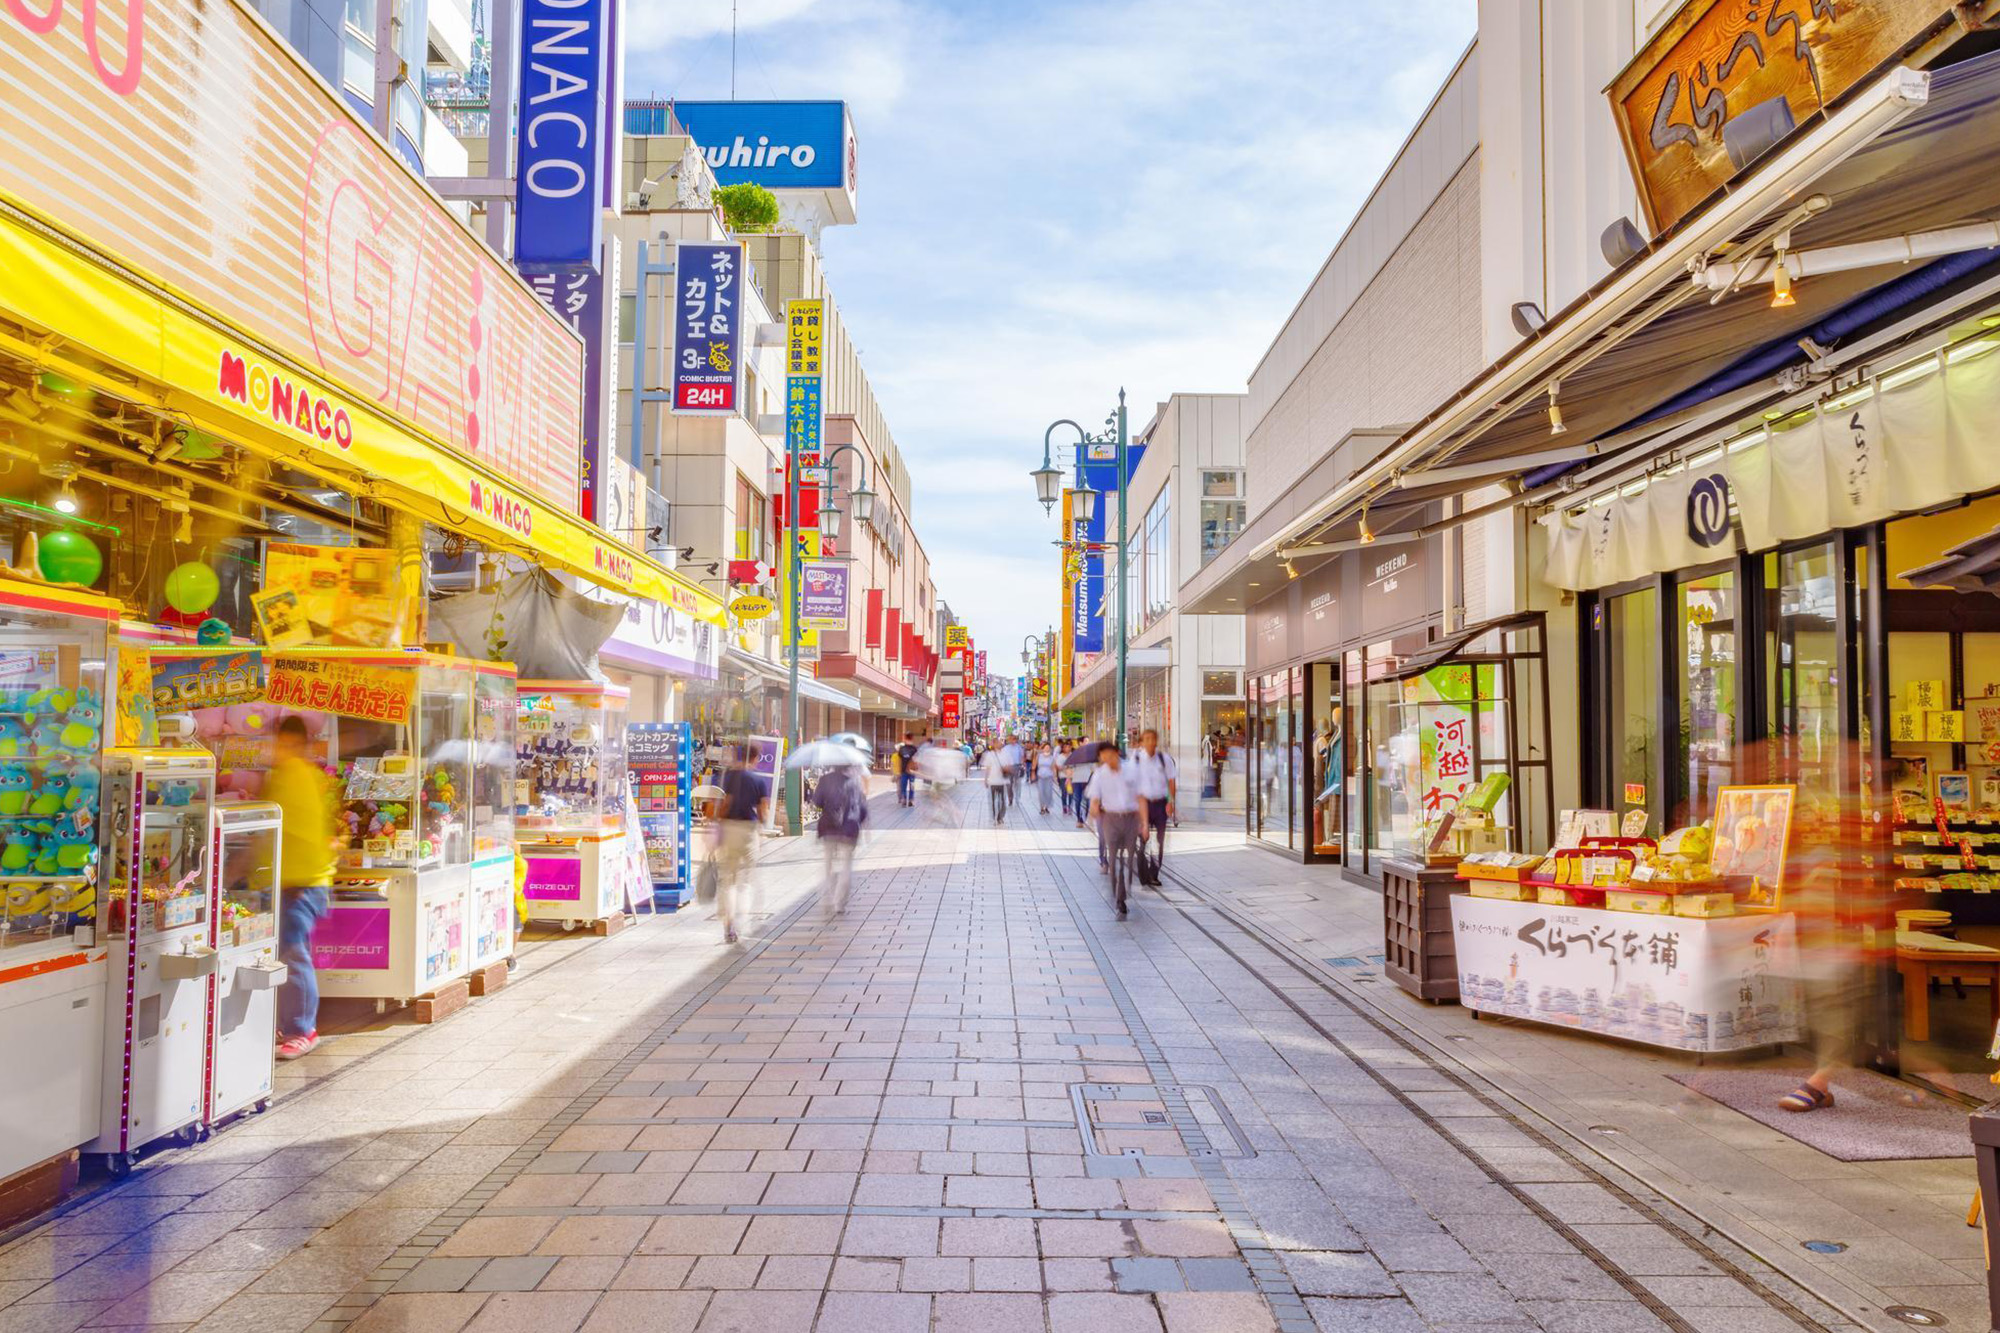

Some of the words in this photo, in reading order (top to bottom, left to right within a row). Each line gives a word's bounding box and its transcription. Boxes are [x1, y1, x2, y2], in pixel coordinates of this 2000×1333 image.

[698, 136, 816, 168] uhiro
[710, 251, 734, 335] ネット&
[685, 278, 707, 338] カフェ
[791, 315, 803, 372] 貸し会議室
[806, 315, 819, 372] 貸し教室
[682, 348, 706, 370] 3F
[679, 375, 704, 383] COMIC
[705, 375, 732, 383] BUSTER
[220, 351, 352, 449] MONACO
[686, 388, 724, 405] 24H
[470, 479, 532, 536] MONACO
[595, 546, 633, 584] MONACO
[1375, 553, 1408, 579] WEEKEND
[672, 585, 698, 613] MONACO
[948, 628, 966, 645] 薬
[269, 674, 407, 721] かんたん設定台
[628, 732, 678, 742] ネットカフェ
[629, 761, 657, 769] nternet
[643, 774, 662, 782] OPEN
[663, 774, 677, 782] 24H
[646, 839, 672, 849] 1300
[315, 945, 355, 955] PRIZE
[356, 945, 384, 955] OUT
